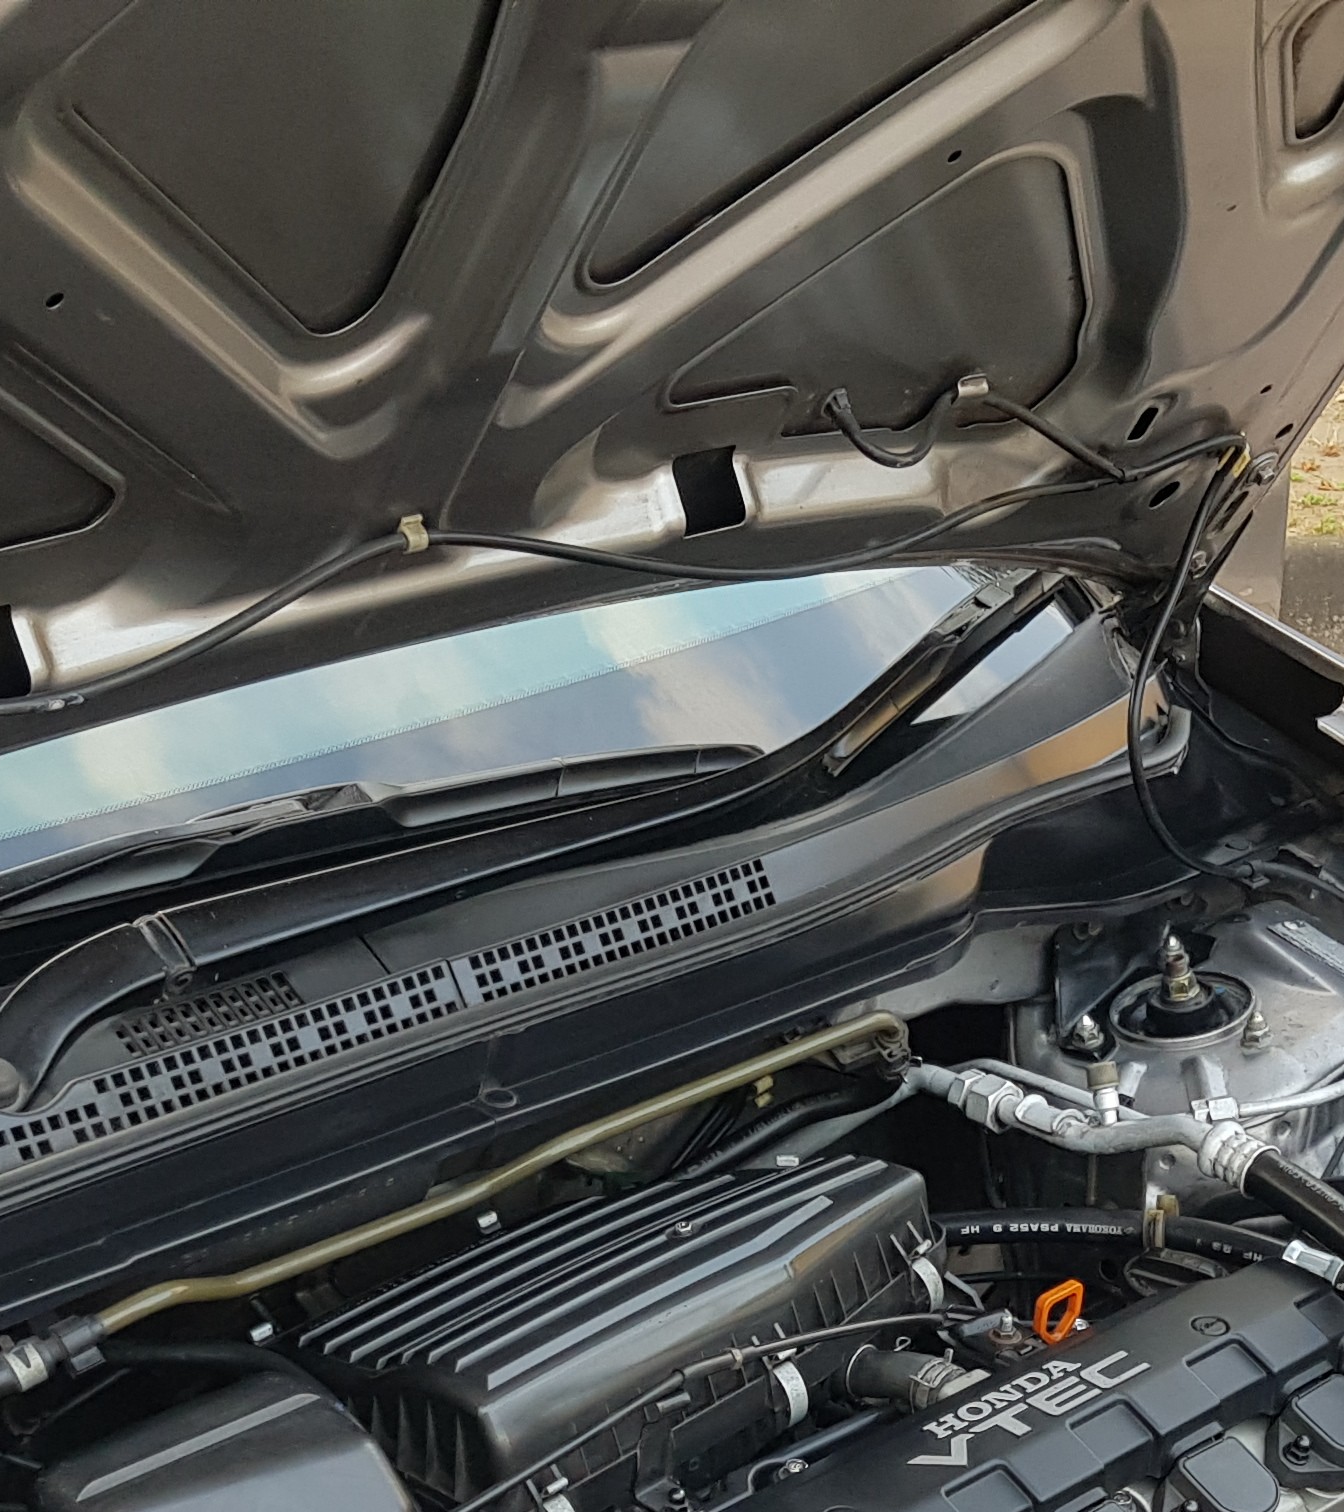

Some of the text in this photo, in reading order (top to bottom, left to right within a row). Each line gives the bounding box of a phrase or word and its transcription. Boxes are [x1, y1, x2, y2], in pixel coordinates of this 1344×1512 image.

[960, 1224, 980, 1235] HF
[1009, 1223, 1059, 1232] PSA52
[1065, 1223, 1124, 1235] YOKOHAMA
[922, 1360, 1082, 1439] HONDA
[906, 1350, 1152, 1466] VTEC
